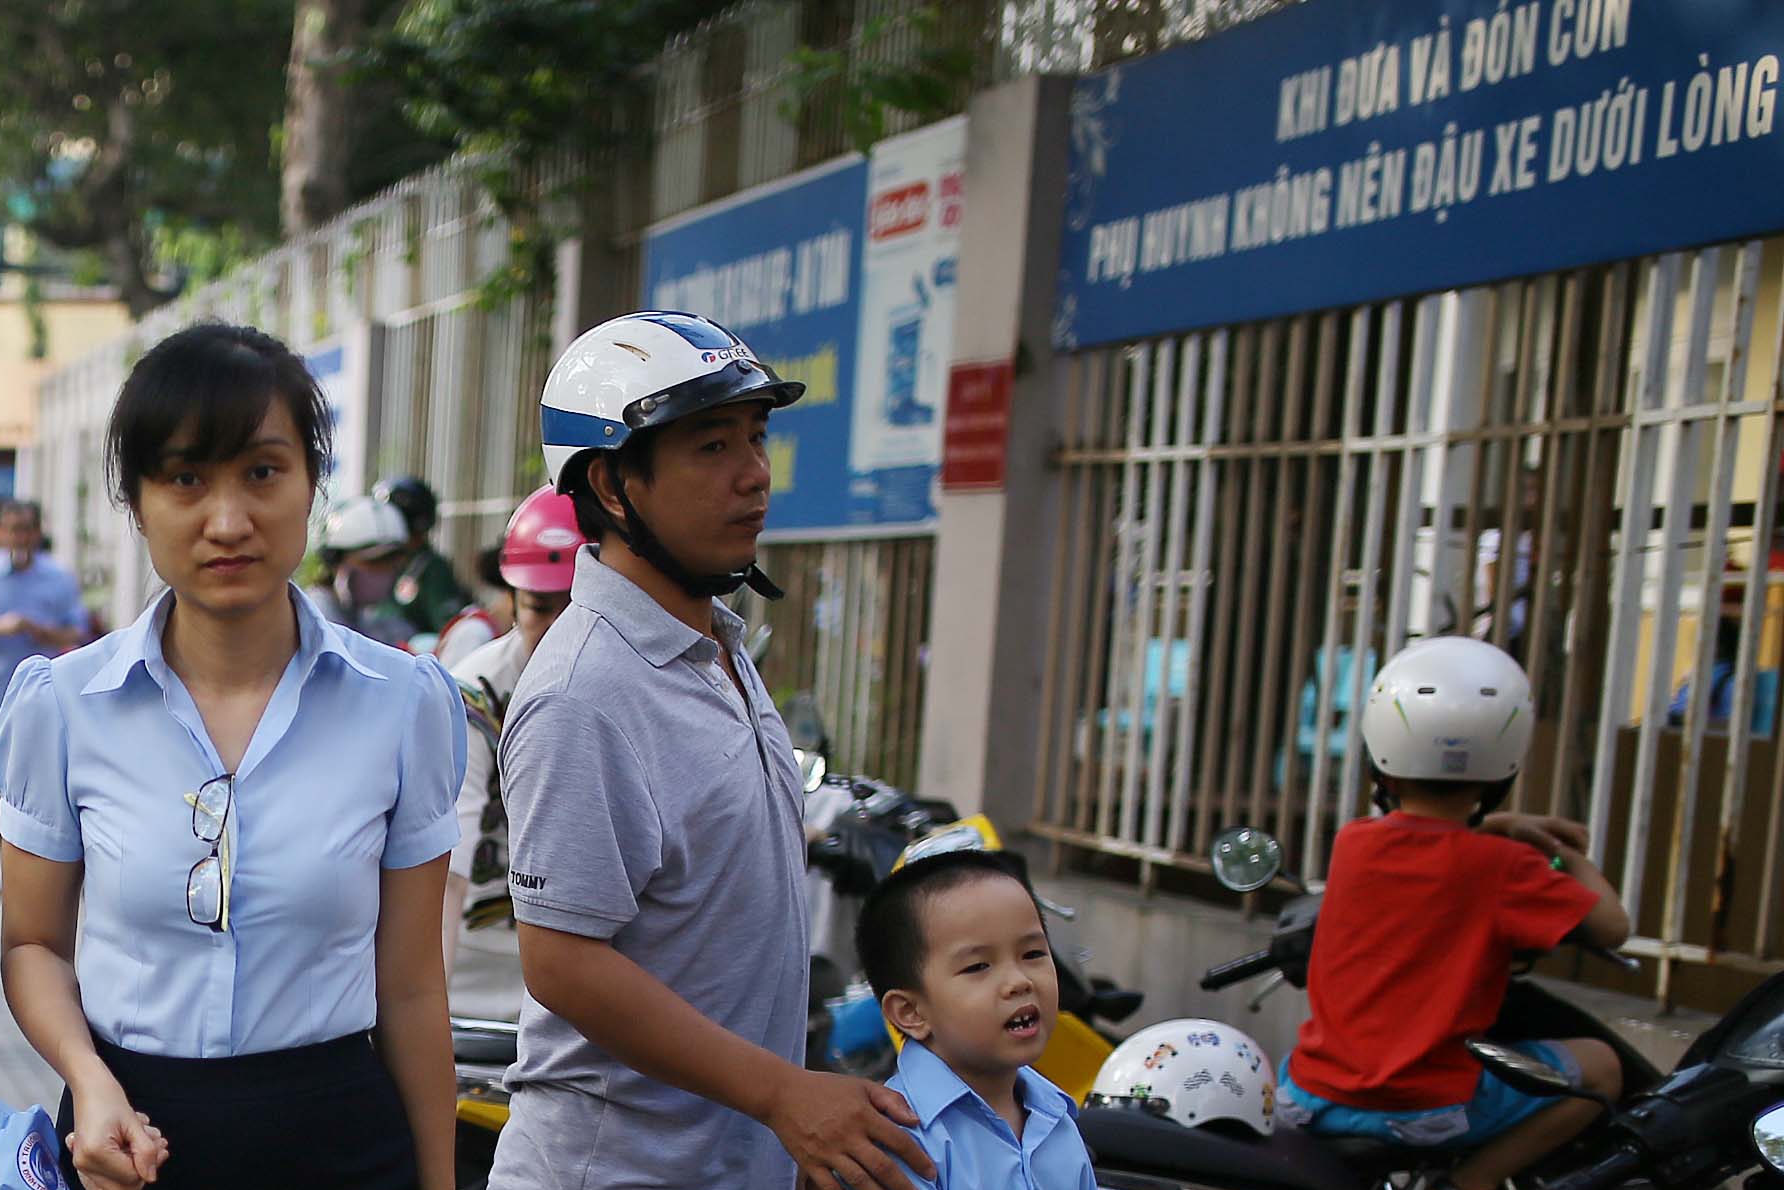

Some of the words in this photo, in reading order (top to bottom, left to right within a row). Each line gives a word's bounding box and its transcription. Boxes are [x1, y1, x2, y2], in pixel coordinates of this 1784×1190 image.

[1276, 65, 1332, 142] KHI
[1488, 115, 1542, 197] XE
[1547, 76, 1649, 183] DƯỚI
[1656, 53, 1781, 158] LÒNG
[510, 870, 547, 890] TOMMY
